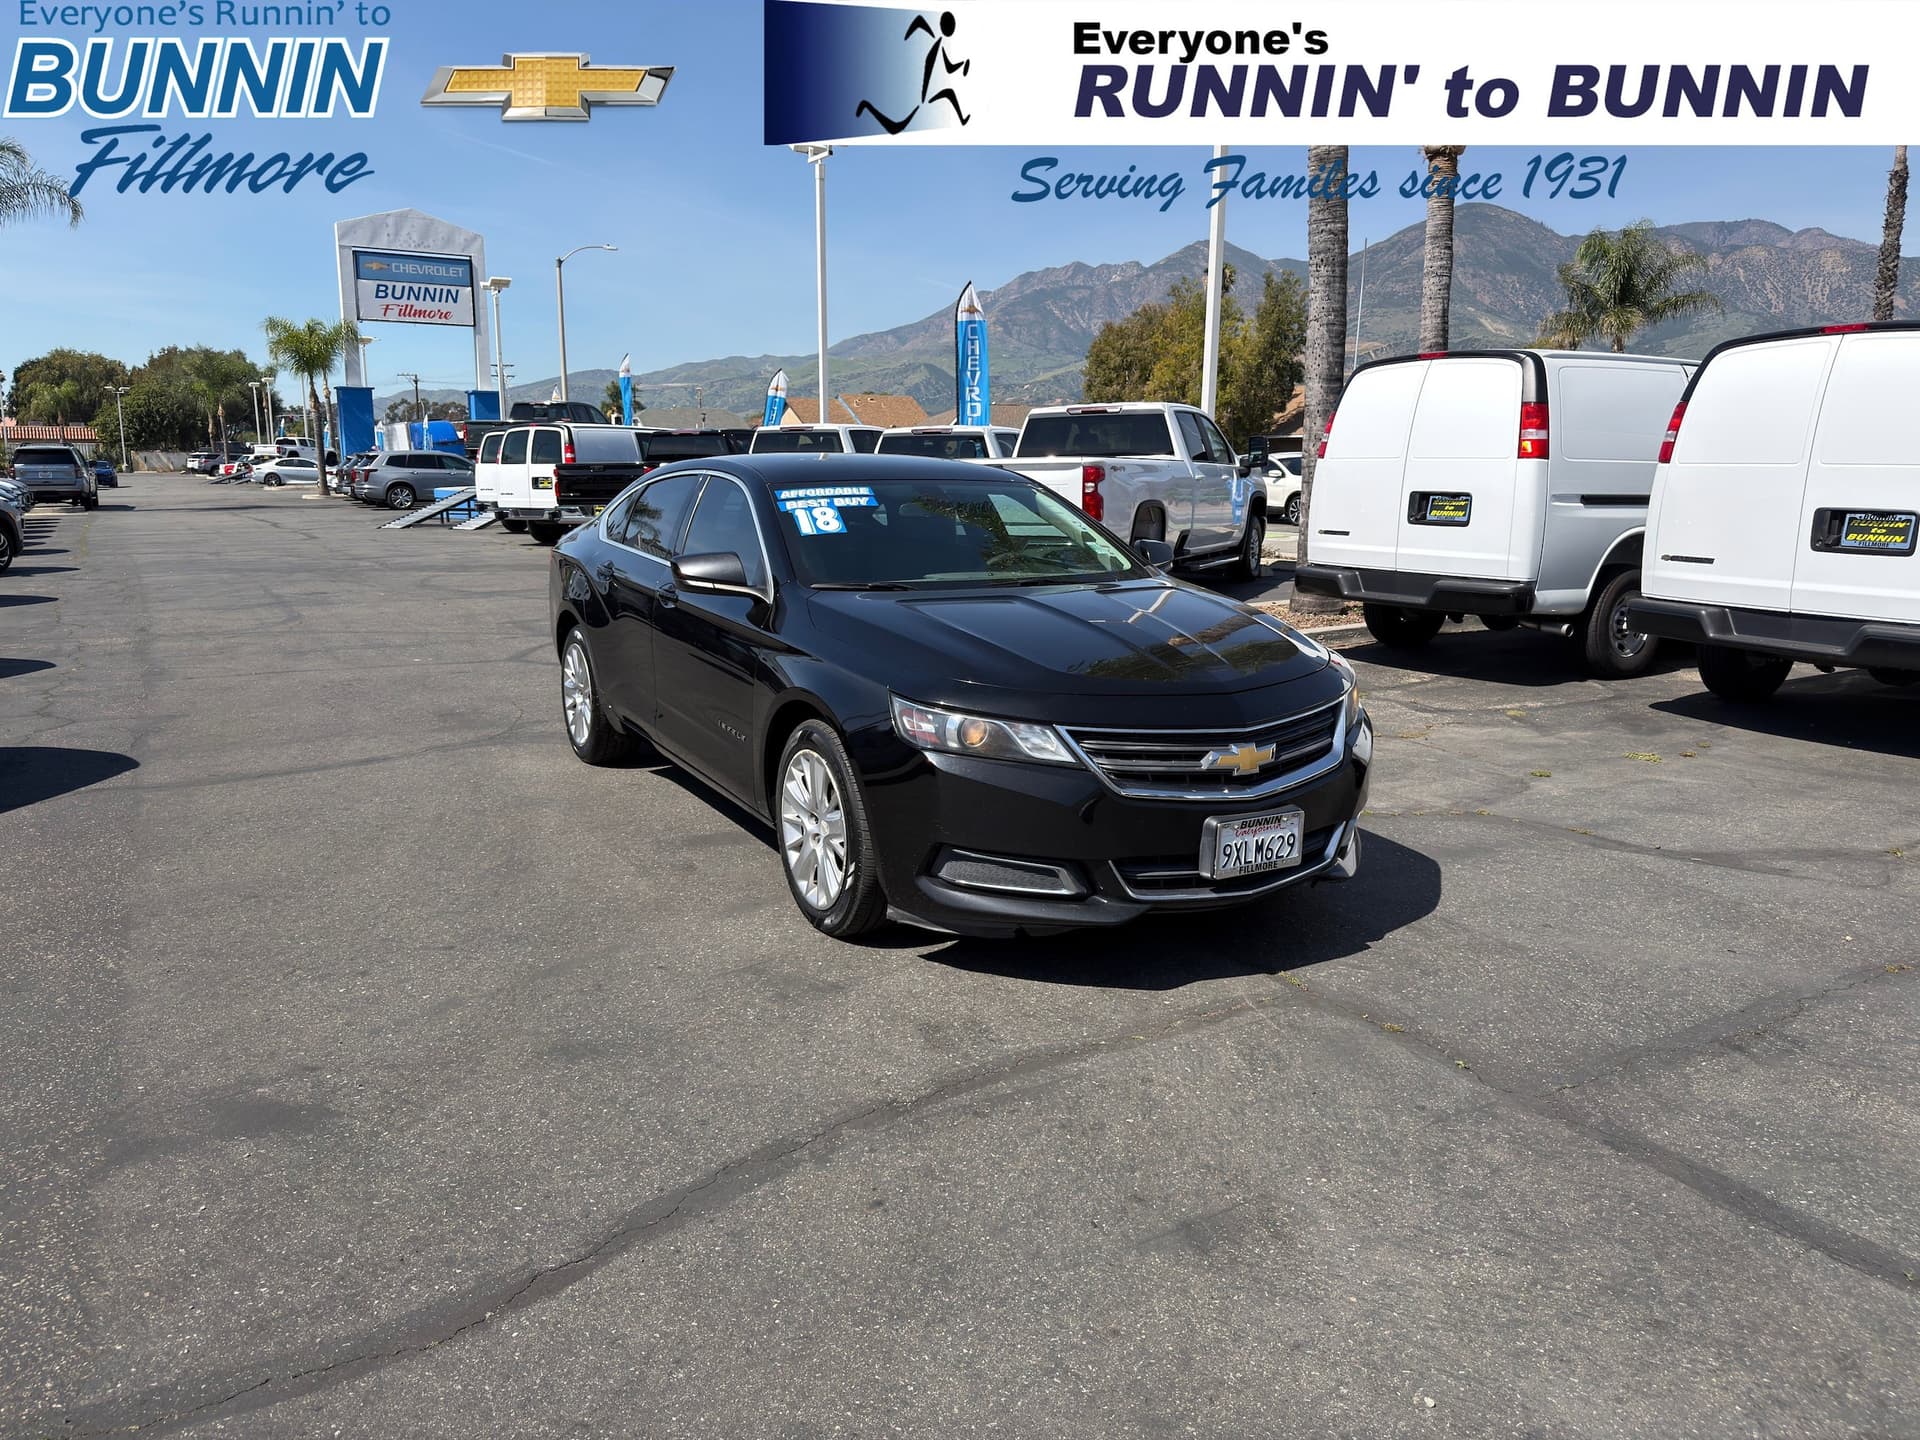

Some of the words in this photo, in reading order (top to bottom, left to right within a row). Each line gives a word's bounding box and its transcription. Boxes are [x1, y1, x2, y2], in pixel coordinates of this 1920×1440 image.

[391, 262, 465, 278] CHEVROLET
[374, 283, 460, 304] BUNNIN
[379, 303, 454, 320] Fillmore
[780, 487, 870, 499] AFFORDABLE
[786, 498, 829, 510] BEST
[833, 497, 869, 507] BUY
[795, 506, 842, 534] 18
[1846, 533, 1905, 542] BUNNIN
[1240, 815, 1283, 829] BUNNIN
[1221, 832, 1297, 869] 9XLM629
[1239, 860, 1278, 874] FILLMORE
